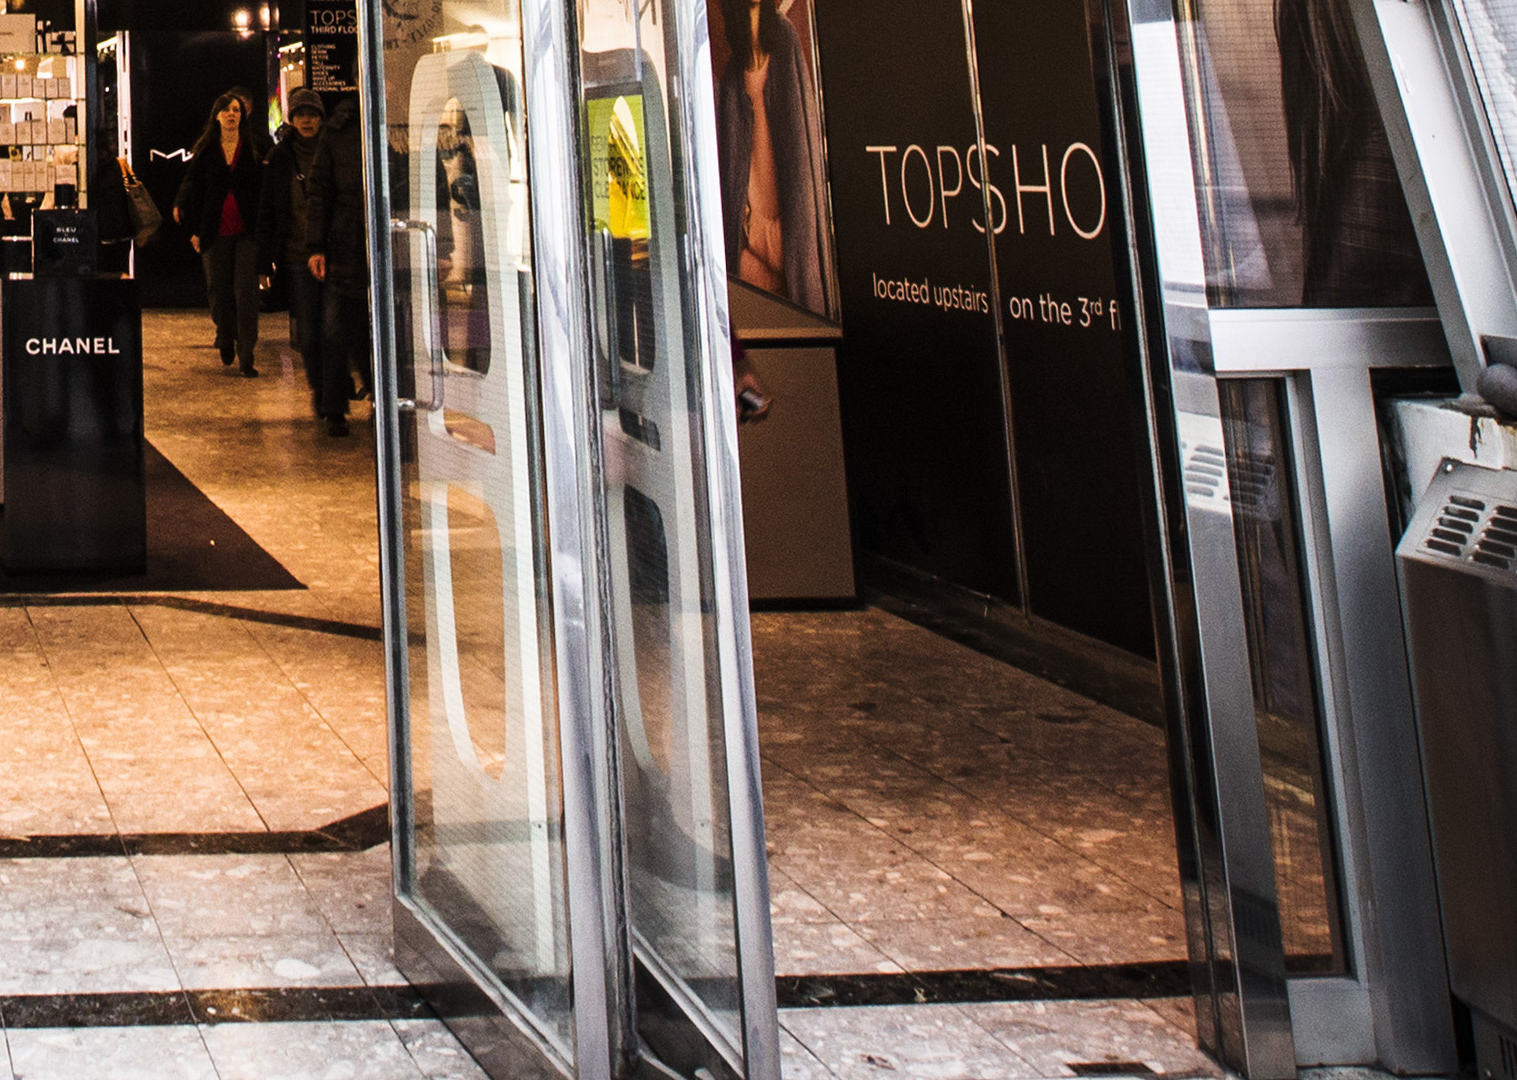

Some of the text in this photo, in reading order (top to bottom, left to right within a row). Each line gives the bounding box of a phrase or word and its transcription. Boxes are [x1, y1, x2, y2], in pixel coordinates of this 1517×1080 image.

[311, 25, 337, 34] THIRD
[865, 142, 1106, 240] TOPSHO
[872, 272, 930, 304] located
[934, 284, 989, 314] upstairs
[1009, 296, 1034, 320] on
[1039, 293, 1072, 326] the
[25, 337, 121, 355] CHANEL
